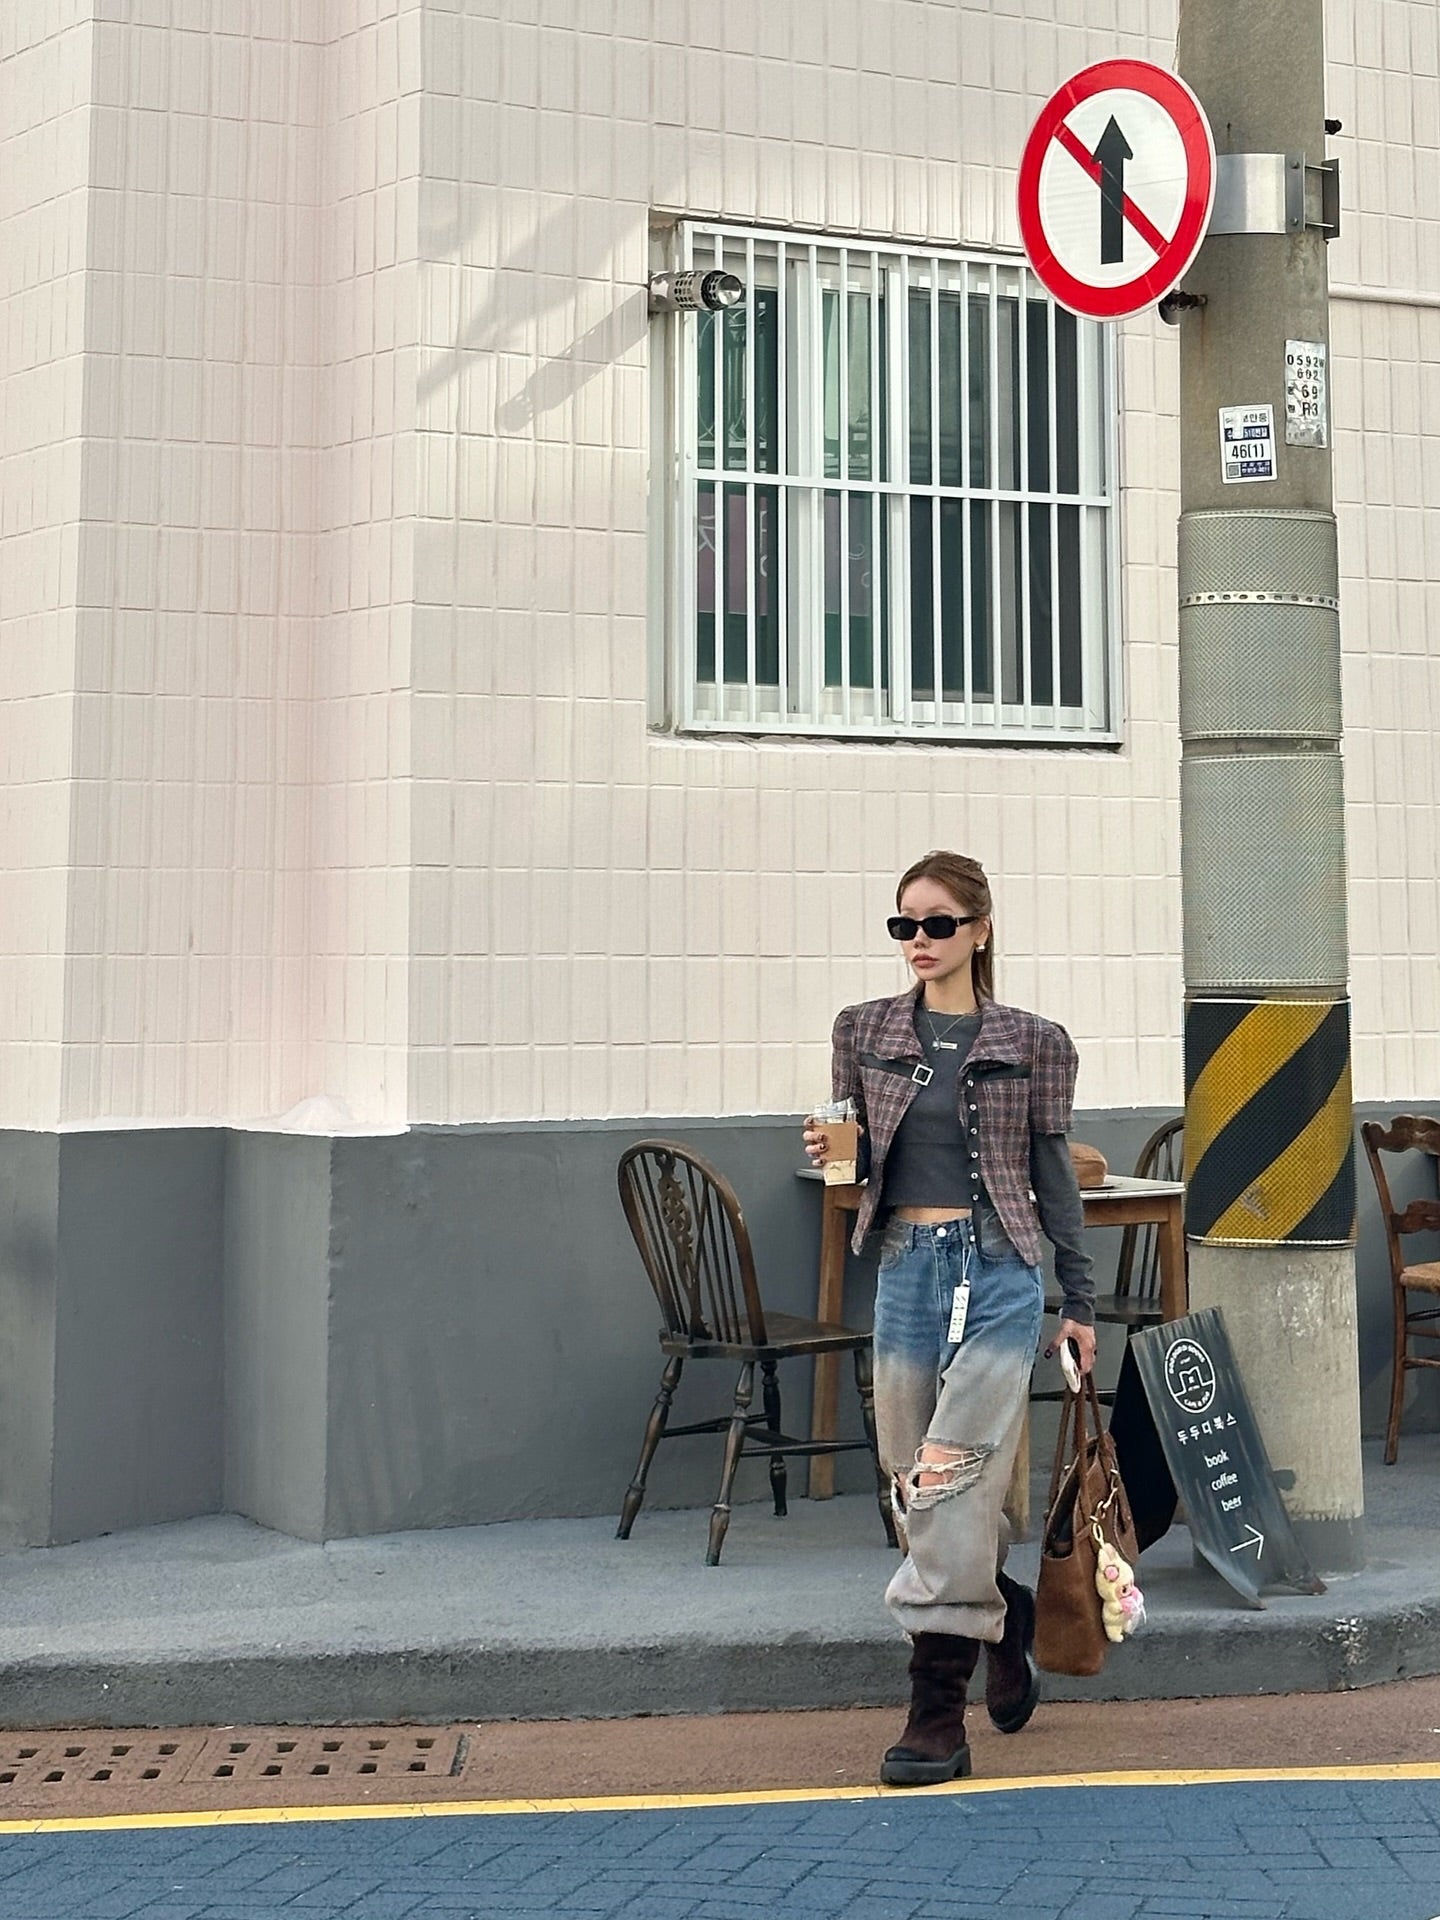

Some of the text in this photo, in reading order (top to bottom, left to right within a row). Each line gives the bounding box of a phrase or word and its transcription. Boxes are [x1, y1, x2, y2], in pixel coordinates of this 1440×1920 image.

[1301, 384, 1318, 400] 69
[1231, 443, 1265, 459] 46(1)
[1177, 1412, 1237, 1445] 두두디북스
[1204, 1449, 1229, 1468] book
[1211, 1472, 1238, 1491] coffee
[1221, 1496, 1241, 1511] beer
